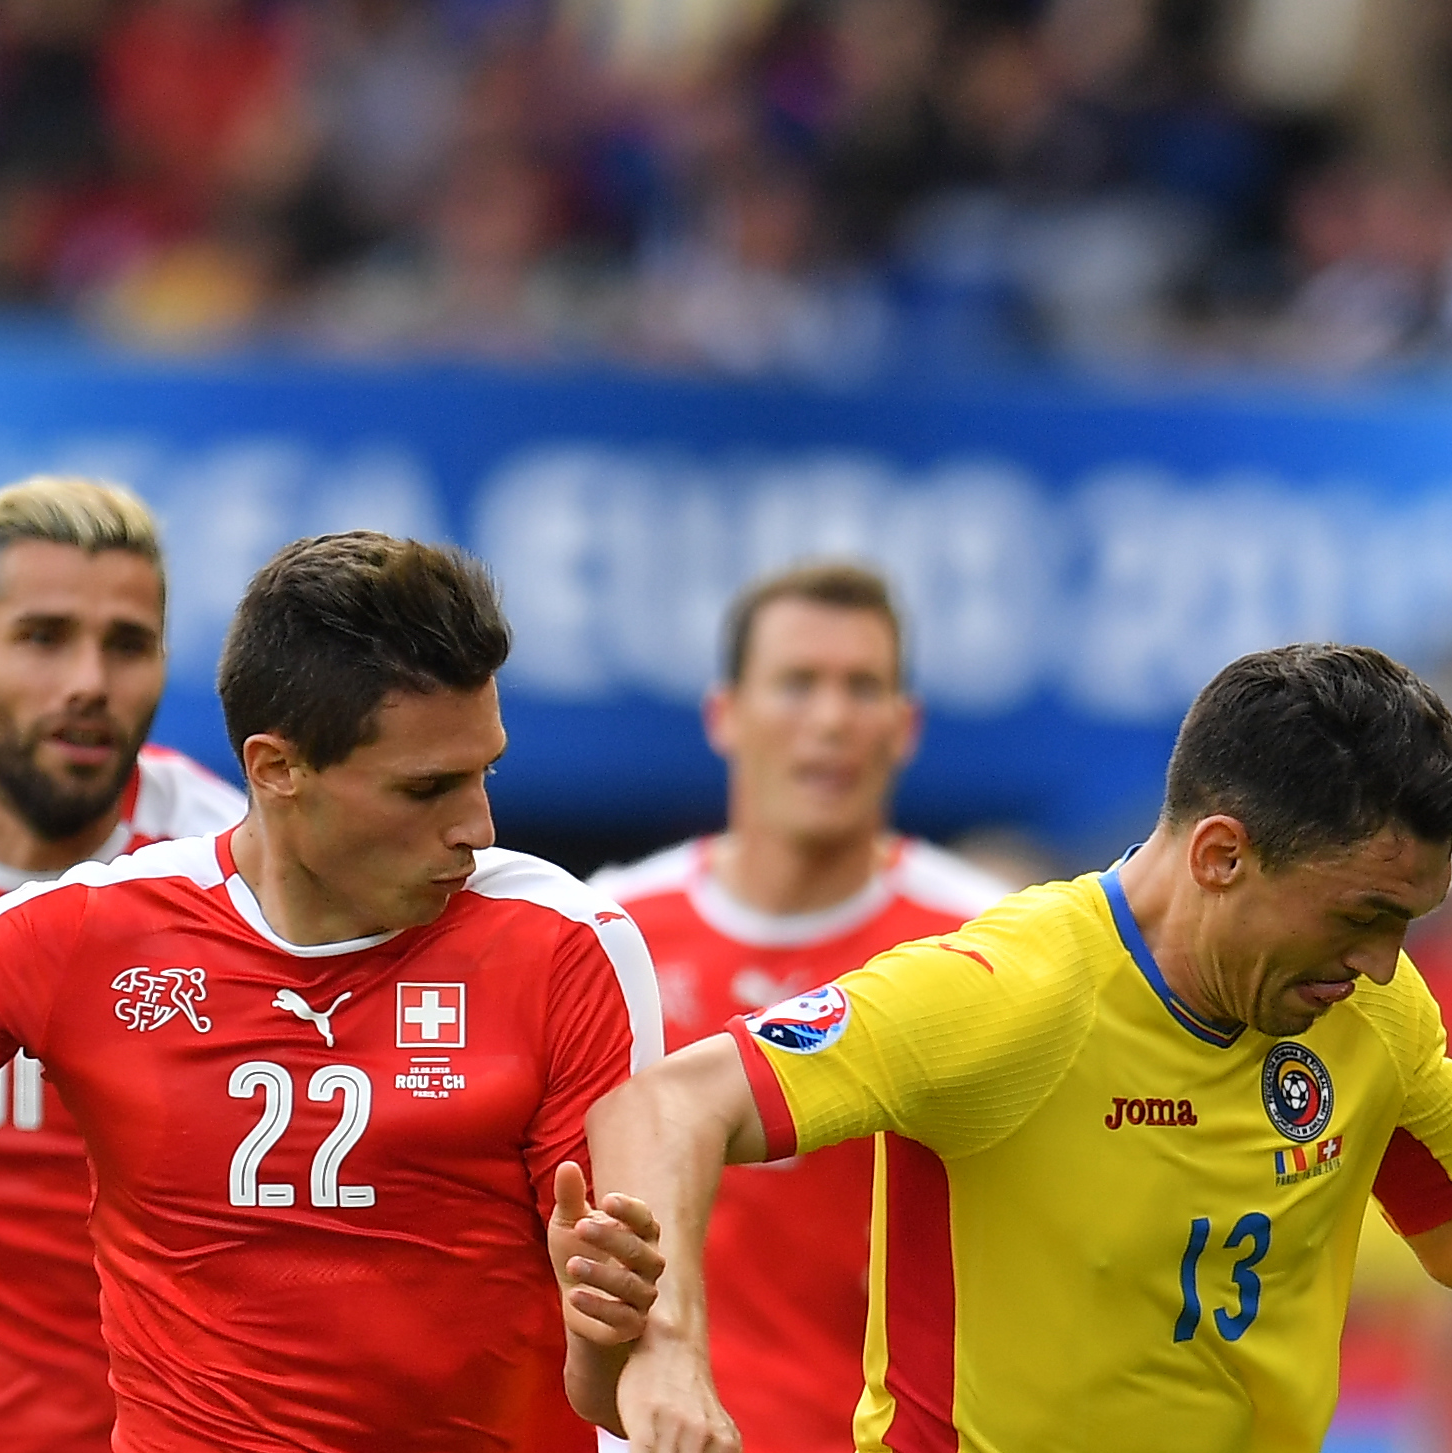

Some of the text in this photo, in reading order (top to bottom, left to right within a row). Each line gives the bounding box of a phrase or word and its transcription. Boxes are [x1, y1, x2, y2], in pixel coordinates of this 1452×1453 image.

[228, 1060, 376, 1208] 22
[394, 1074, 430, 1090] ROU
[442, 1074, 466, 1090] CH
[1173, 1211, 1272, 1344] 13
